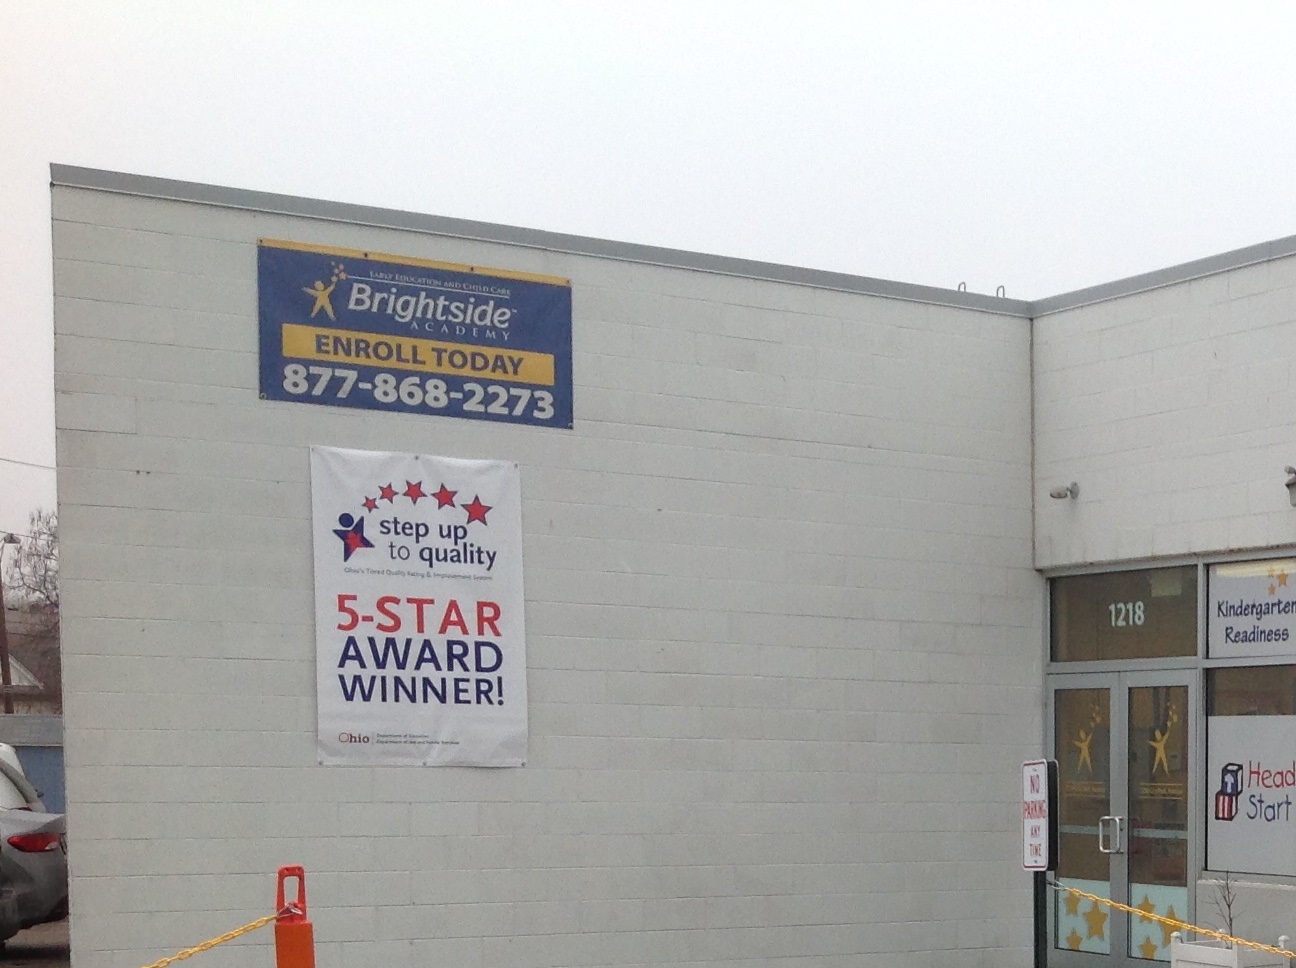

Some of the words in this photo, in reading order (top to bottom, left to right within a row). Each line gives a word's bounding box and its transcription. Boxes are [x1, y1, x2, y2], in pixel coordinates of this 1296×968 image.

[347, 282, 511, 328] Brightside
[411, 321, 510, 341] ACADEMY
[314, 333, 426, 366] ENROLL
[431, 347, 525, 376] TODAY
[282, 363, 555, 420] 877-868-2273
[379, 517, 429, 544] step
[439, 523, 468, 545] up
[389, 541, 410, 561] to
[419, 542, 497, 571] quality
[336, 593, 502, 637] 5-STAR
[1108, 600, 1145, 627] 1218
[1225, 625, 1289, 644] Readiness
[337, 635, 503, 673] AWARD
[338, 673, 504, 706] WINNER!
[338, 732, 370, 744] Ohio
[1247, 760, 1296, 788] Head
[1246, 793, 1292, 822] Start
